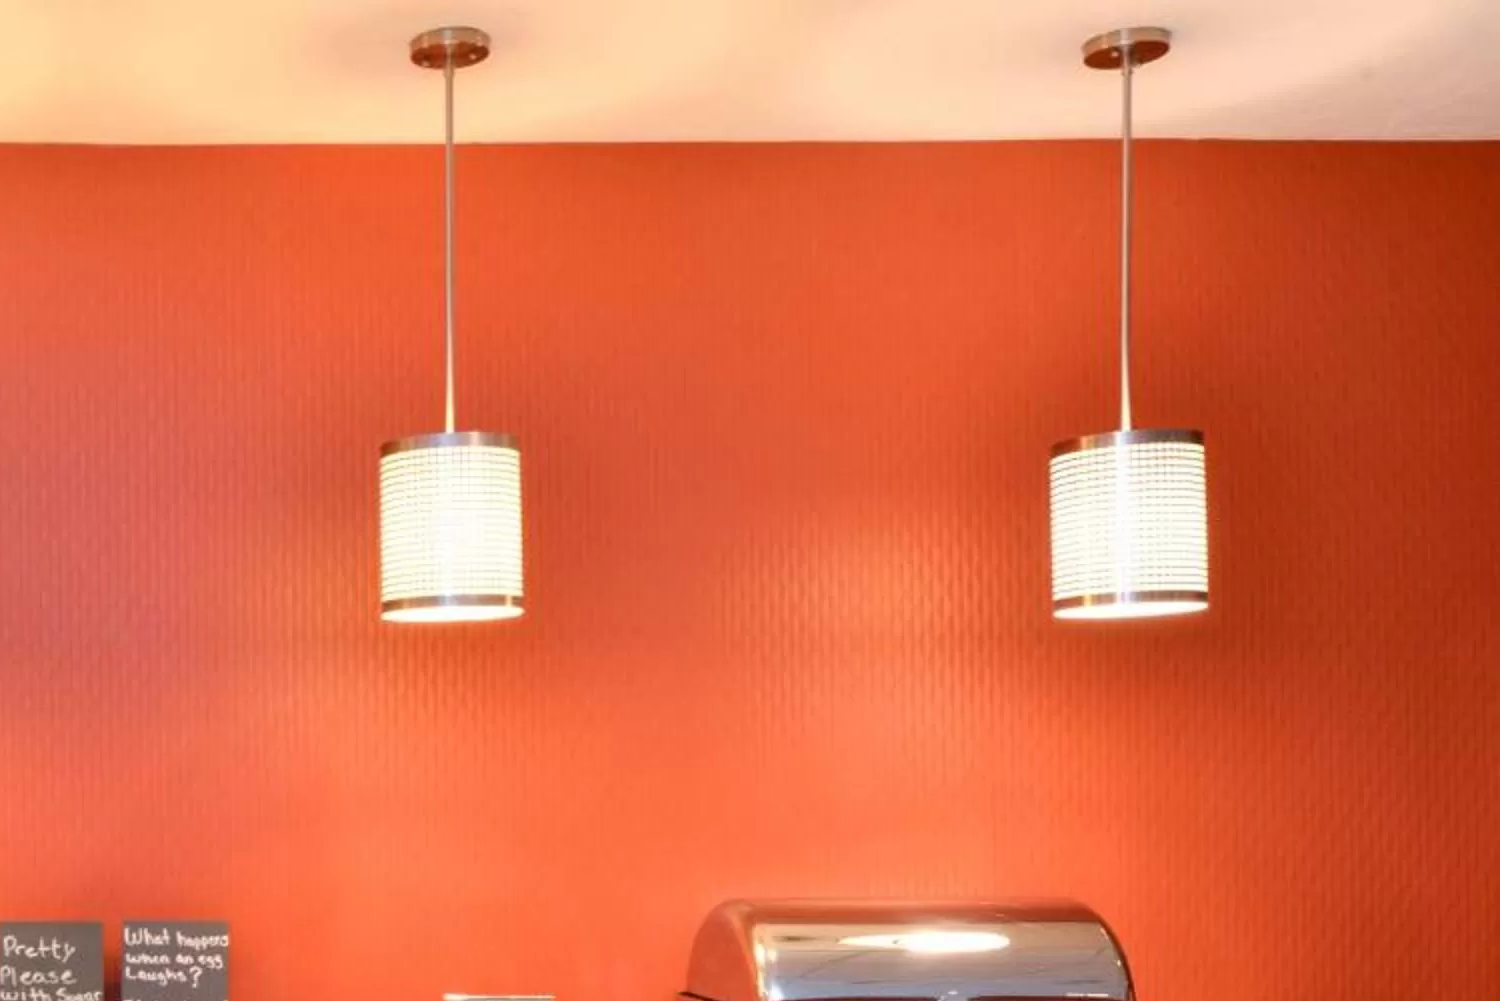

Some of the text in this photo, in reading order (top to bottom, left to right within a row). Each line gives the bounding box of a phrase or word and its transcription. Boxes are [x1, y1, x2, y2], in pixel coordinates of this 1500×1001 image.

[123, 928, 171, 946] What
[3, 934, 76, 963] Pretty
[197, 954, 223, 969] egg
[0, 965, 77, 987] Please
